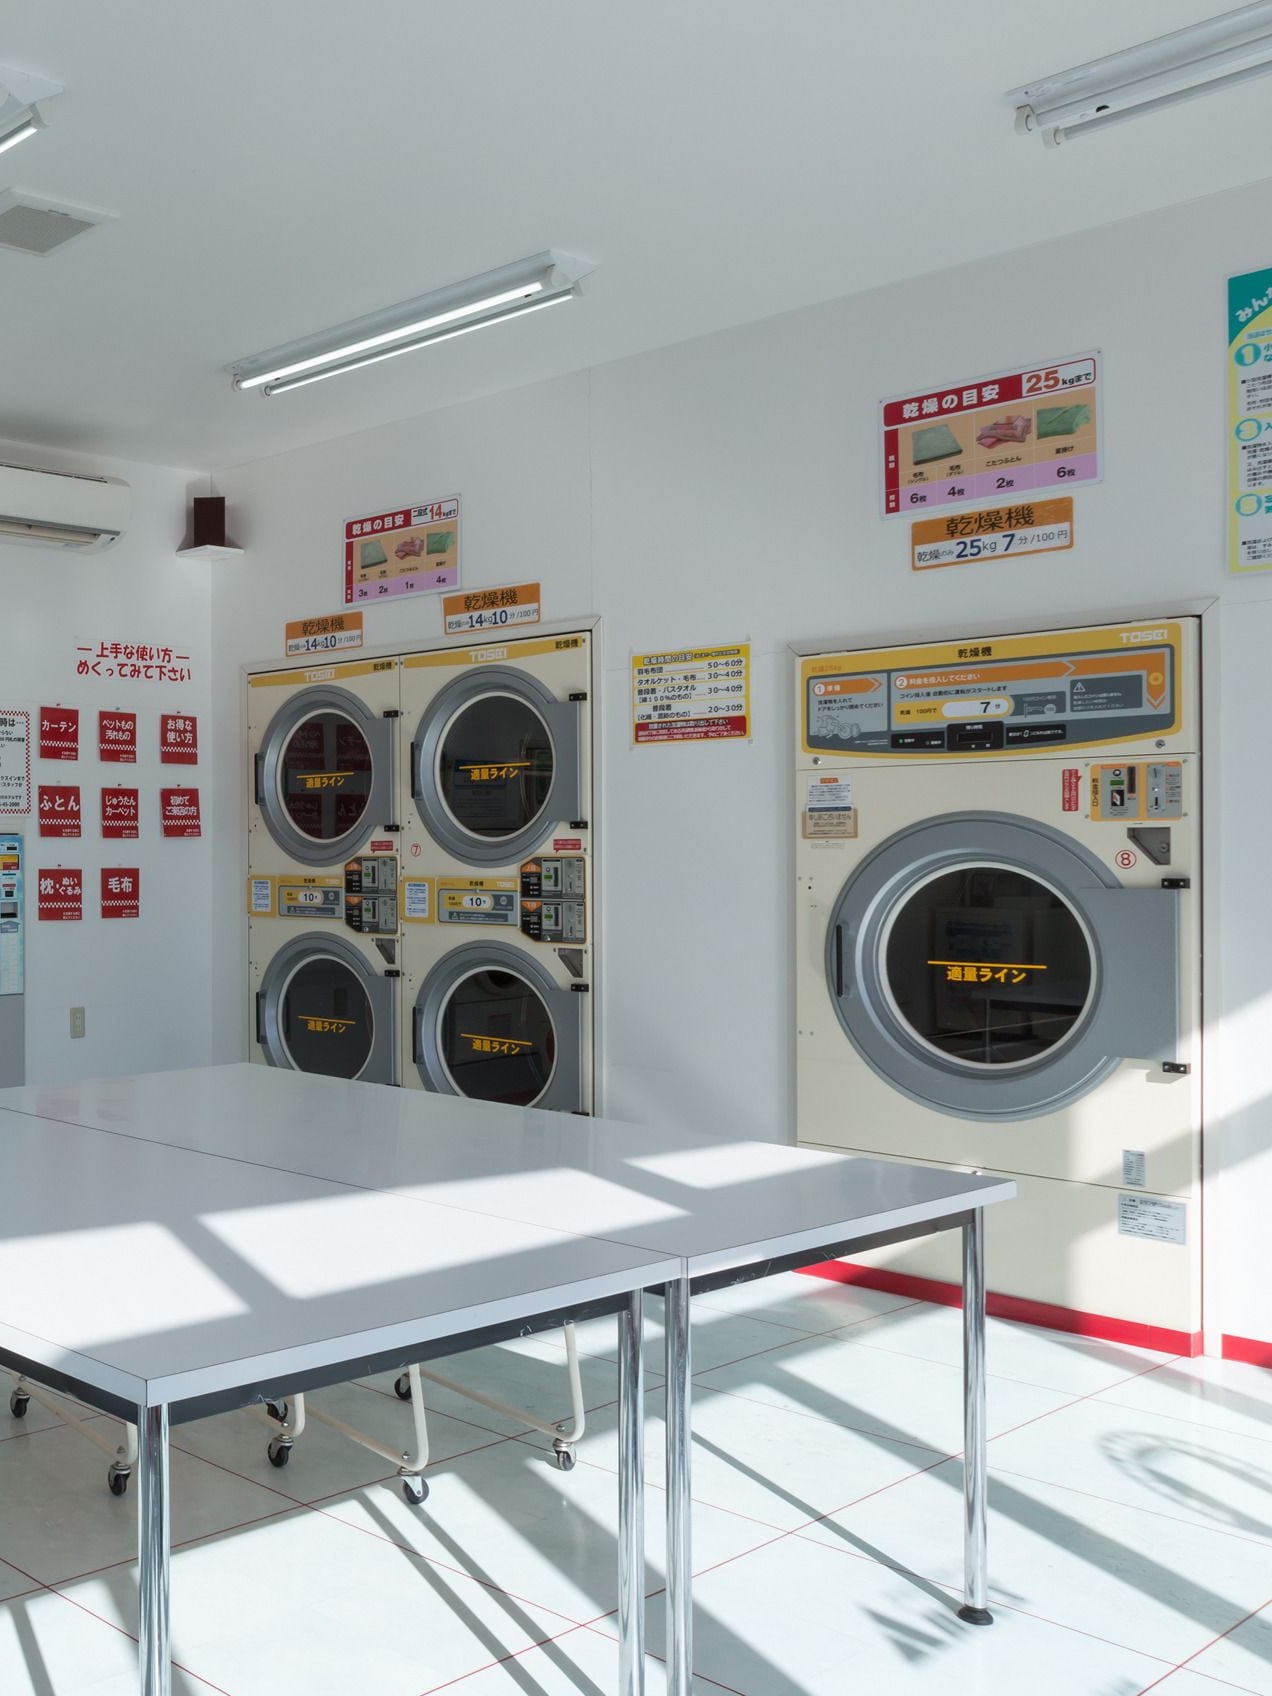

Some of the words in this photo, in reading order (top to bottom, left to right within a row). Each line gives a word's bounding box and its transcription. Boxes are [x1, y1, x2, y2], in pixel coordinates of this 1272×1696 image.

[903, 385, 999, 419] 乾燥の目安
[986, 456, 1021, 467] こたつふとん
[1057, 468, 1075, 478] 6枚
[996, 478, 1014, 488] 2枚
[948, 487, 964, 497] 4枚
[911, 493, 927, 503] 6枚
[352, 515, 404, 535] 乾燥の目安
[946, 506, 1034, 538] 乾燥機
[464, 588, 517, 612] 乾燥機
[302, 617, 344, 635] 乾燥機
[1120, 630, 1168, 642] TOSEI
[469, 648, 507, 661] TOSEI
[555, 638, 579, 650] 乾燥機
[958, 646, 992, 658] 乾燥機
[77, 661, 191, 681] めくってみて下さい
[373, 662, 392, 672] 乾燥機
[909, 674, 980, 685] 料金を投入してください
[42, 721, 77, 732] カーテン
[168, 719, 192, 730] お得な
[106, 730, 130, 740] 汚れもの
[167, 732, 193, 743] 使い方
[471, 768, 519, 780] 適量ライン
[306, 777, 344, 788] 適量ライン
[40, 796, 79, 811] ふとん
[105, 796, 136, 805] じゅうたん
[170, 796, 190, 805] 初めて
[106, 807, 135, 816] カーペット
[166, 807, 196, 816] ご来店の方
[108, 877, 132, 892] 毛布
[59, 886, 81, 895] ぐるみ
[947, 966, 1026, 984] 適量ライン
[307, 1021, 346, 1034] 適量ライン
[472, 1039, 520, 1055] 適量ライン
